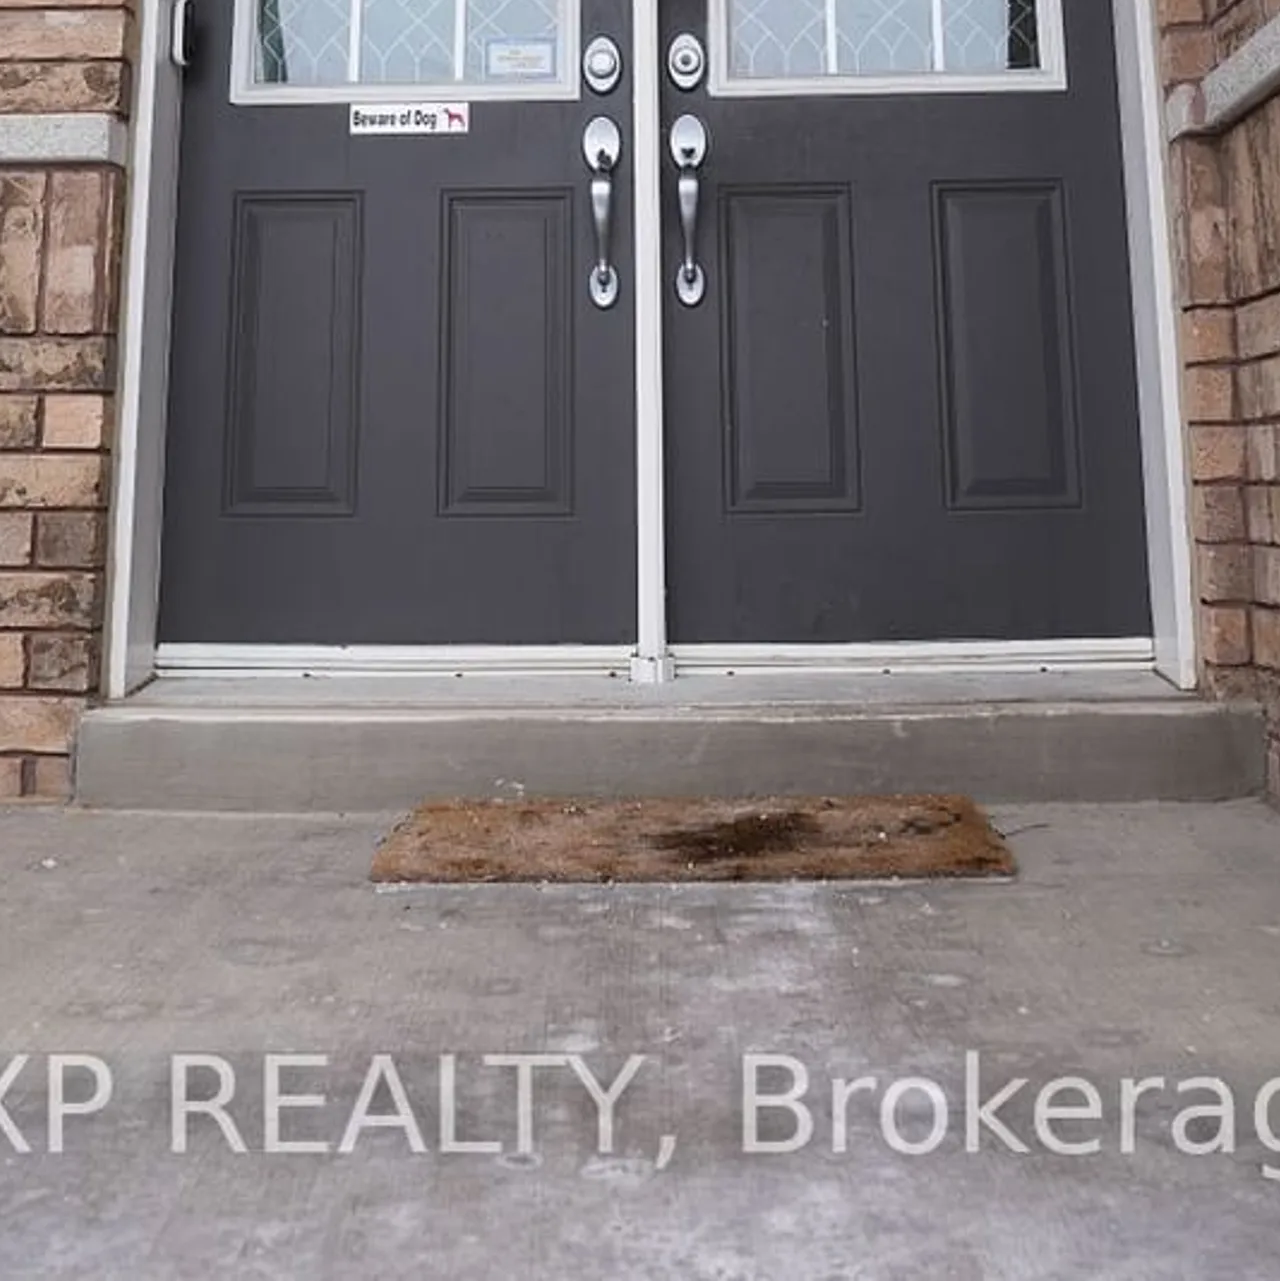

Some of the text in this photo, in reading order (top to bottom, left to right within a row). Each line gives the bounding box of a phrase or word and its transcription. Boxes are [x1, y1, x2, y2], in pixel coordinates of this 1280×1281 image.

[353, 109, 437, 130] Beware of Dog
